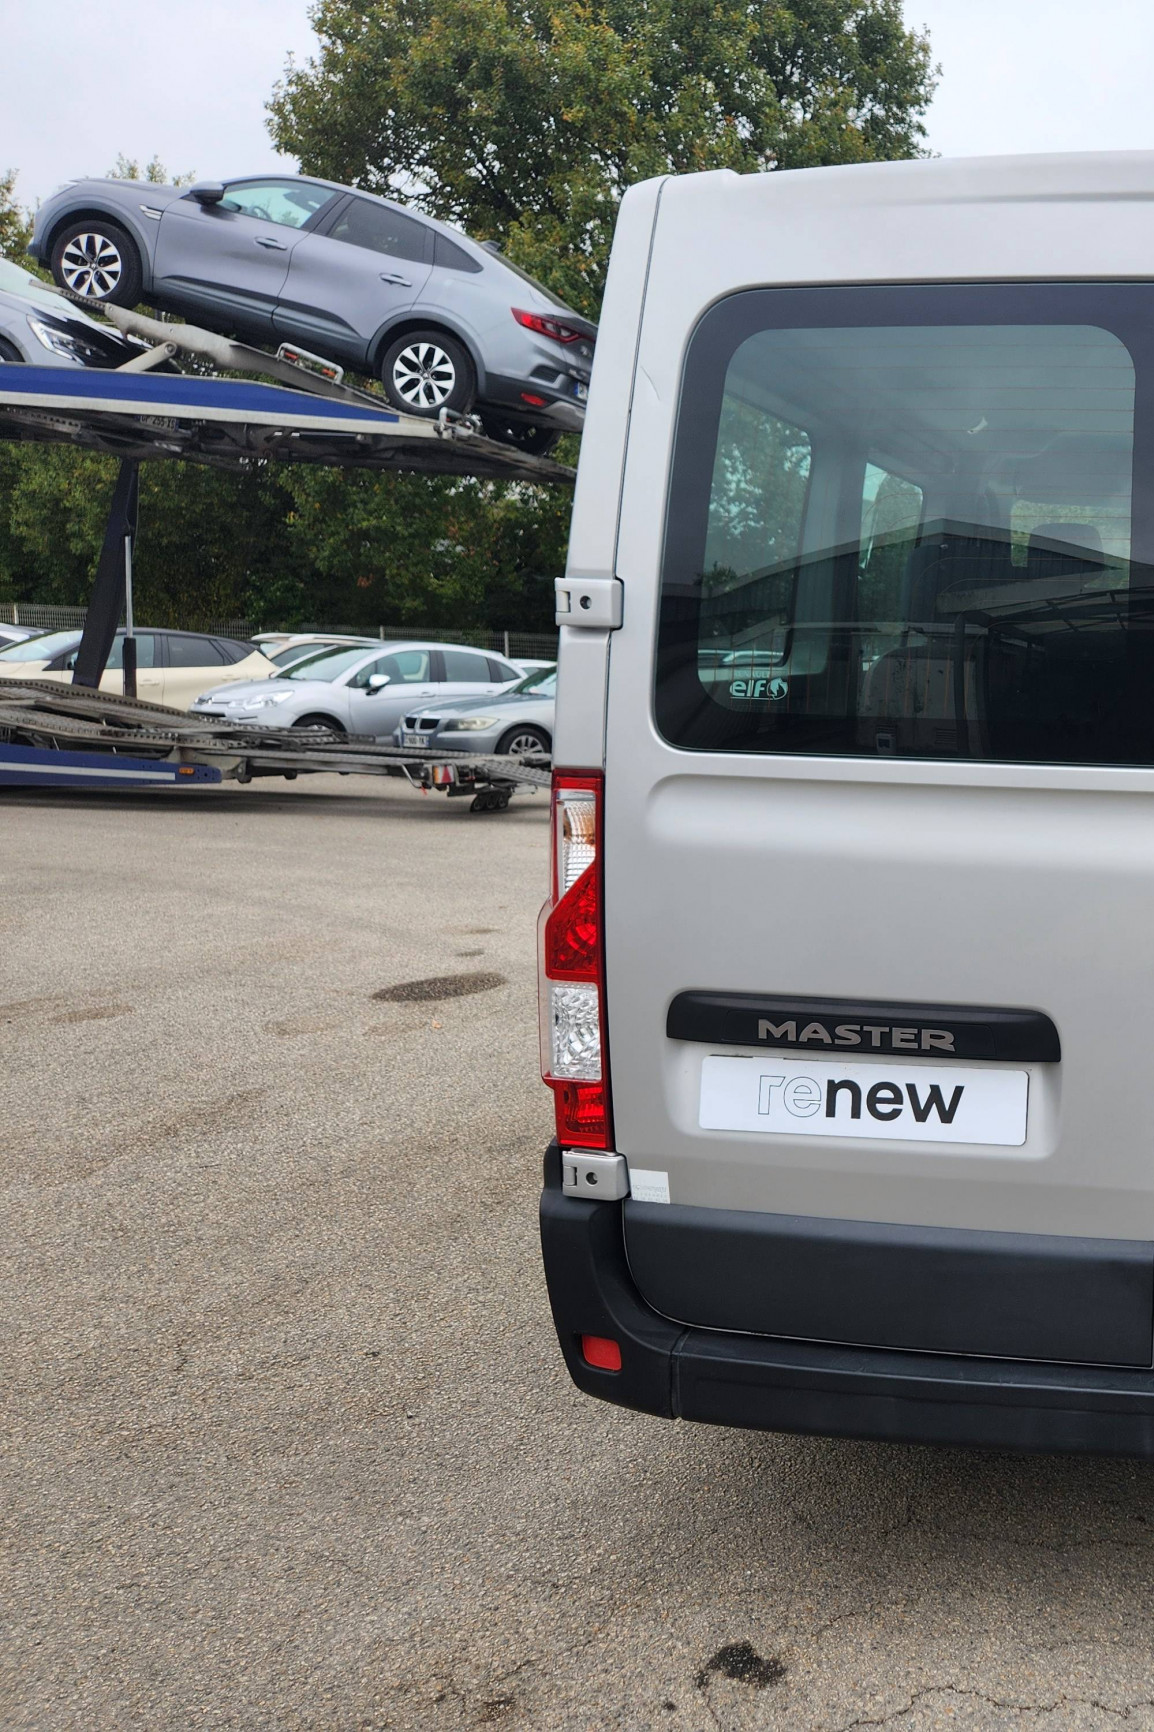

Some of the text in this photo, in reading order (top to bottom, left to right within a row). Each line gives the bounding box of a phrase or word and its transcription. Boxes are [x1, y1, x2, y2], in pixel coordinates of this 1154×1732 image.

[729, 679, 767, 698] elf
[757, 1018, 956, 1053] MASTER
[757, 1074, 966, 1125] renew
